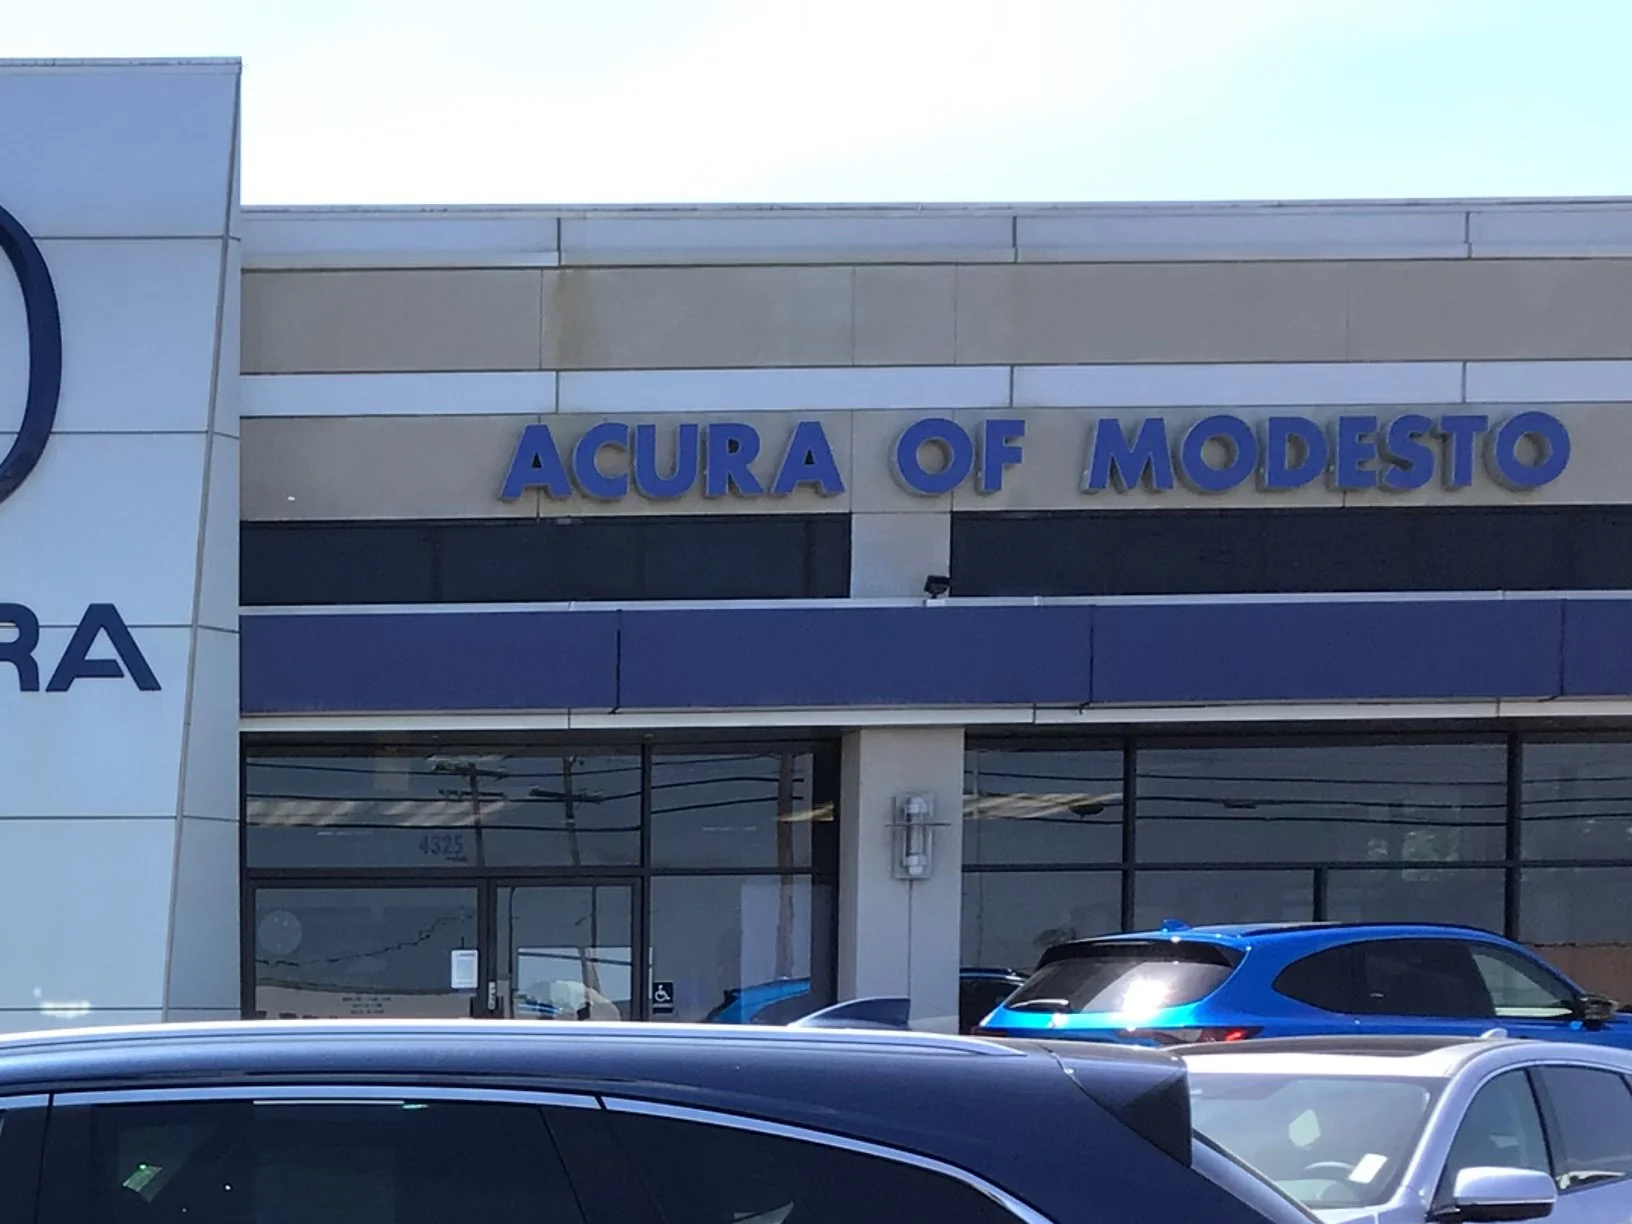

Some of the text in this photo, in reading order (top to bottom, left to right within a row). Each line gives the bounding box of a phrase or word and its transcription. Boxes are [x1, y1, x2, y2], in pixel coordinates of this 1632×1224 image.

[500, 411, 1572, 500] ACURA OF MODESTO
[418, 834, 464, 855] 4325
